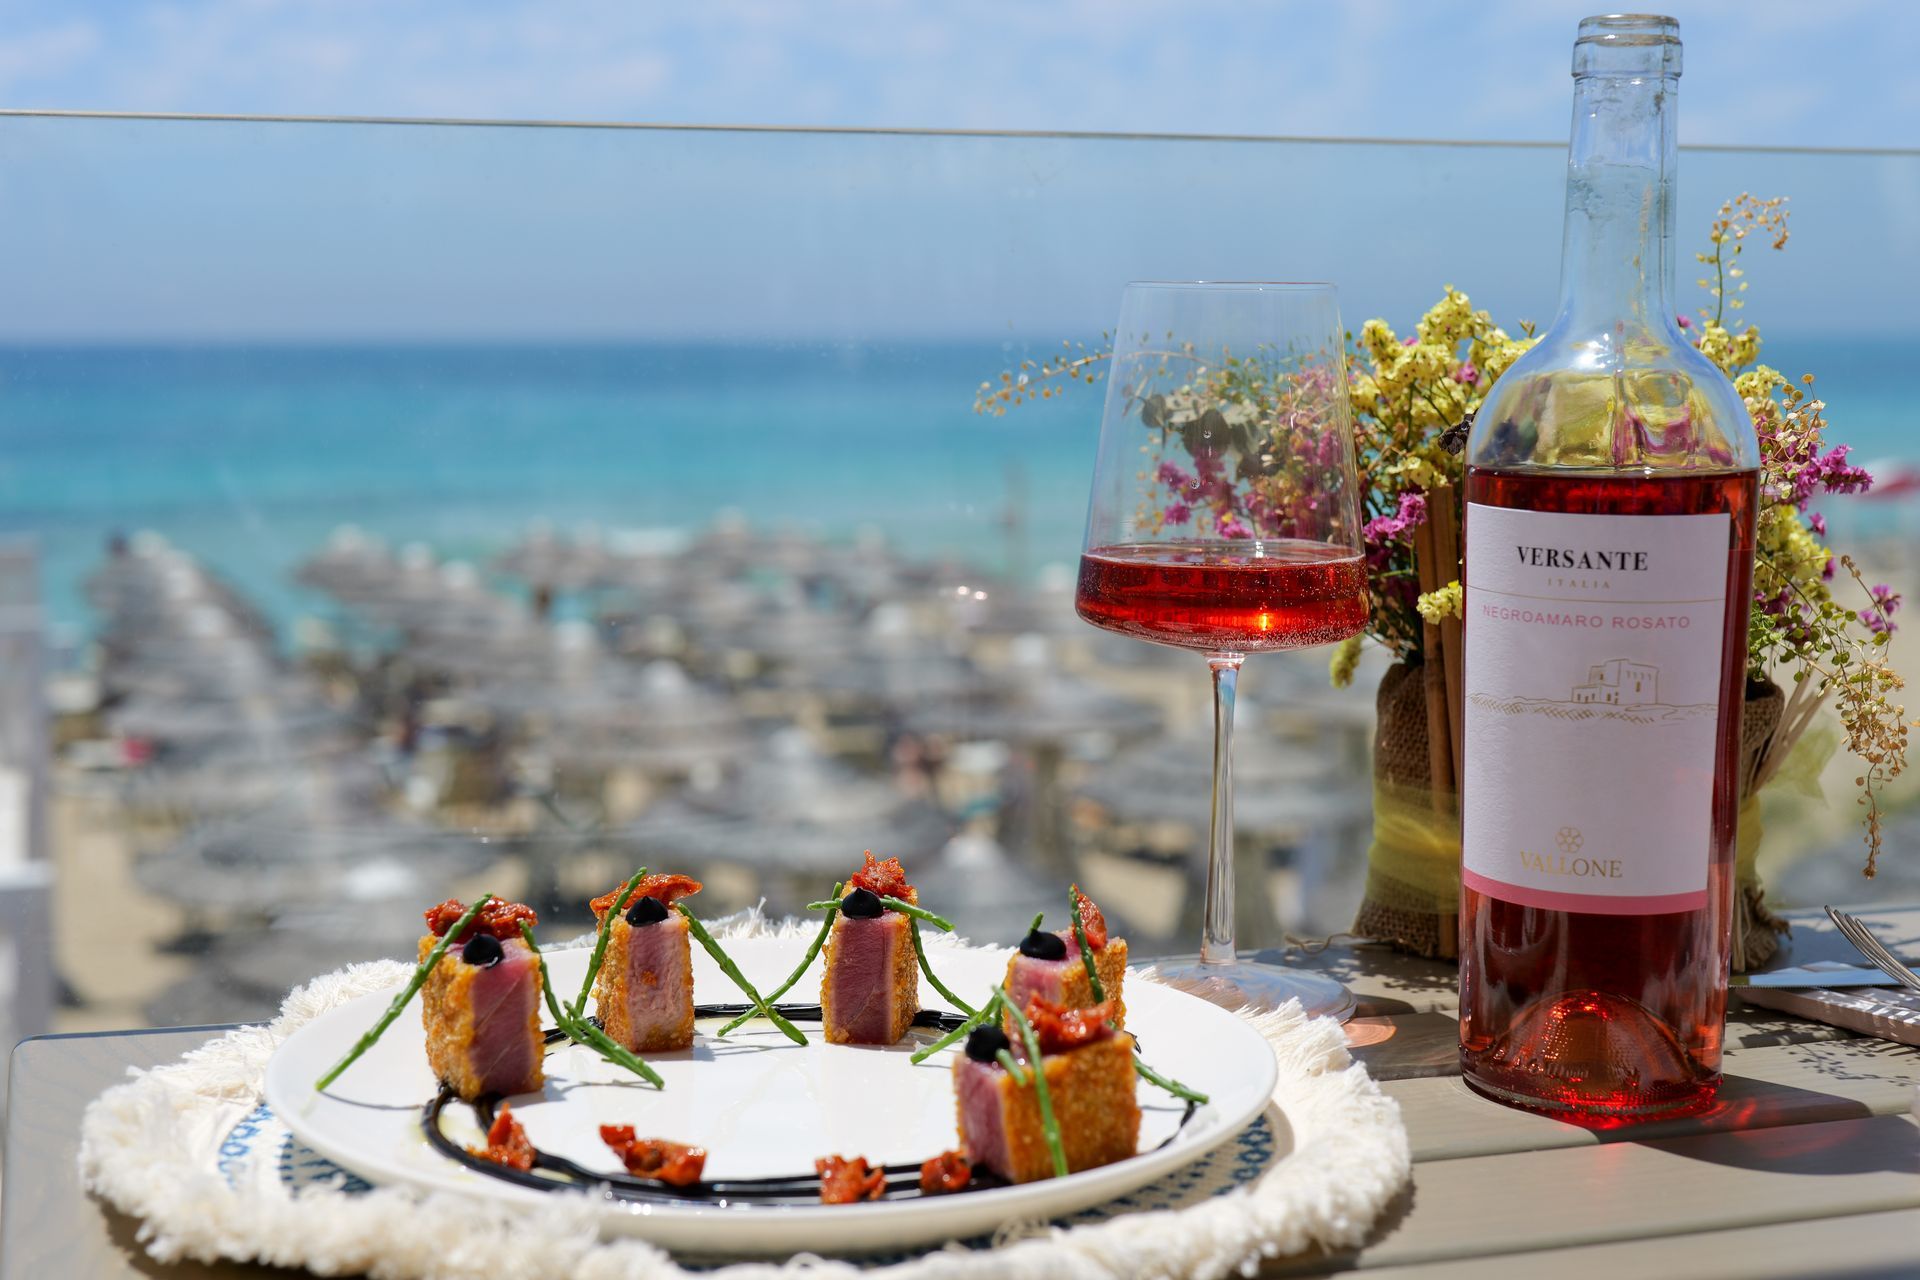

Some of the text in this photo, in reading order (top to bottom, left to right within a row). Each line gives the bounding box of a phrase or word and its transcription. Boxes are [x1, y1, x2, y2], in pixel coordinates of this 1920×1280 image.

[1517, 546, 1648, 571] VERSANTE
[1547, 578, 1610, 589] ITALIA
[1482, 604, 1690, 630] NEGROAMARO ROSATO
[1520, 851, 1622, 878] VALLONE
